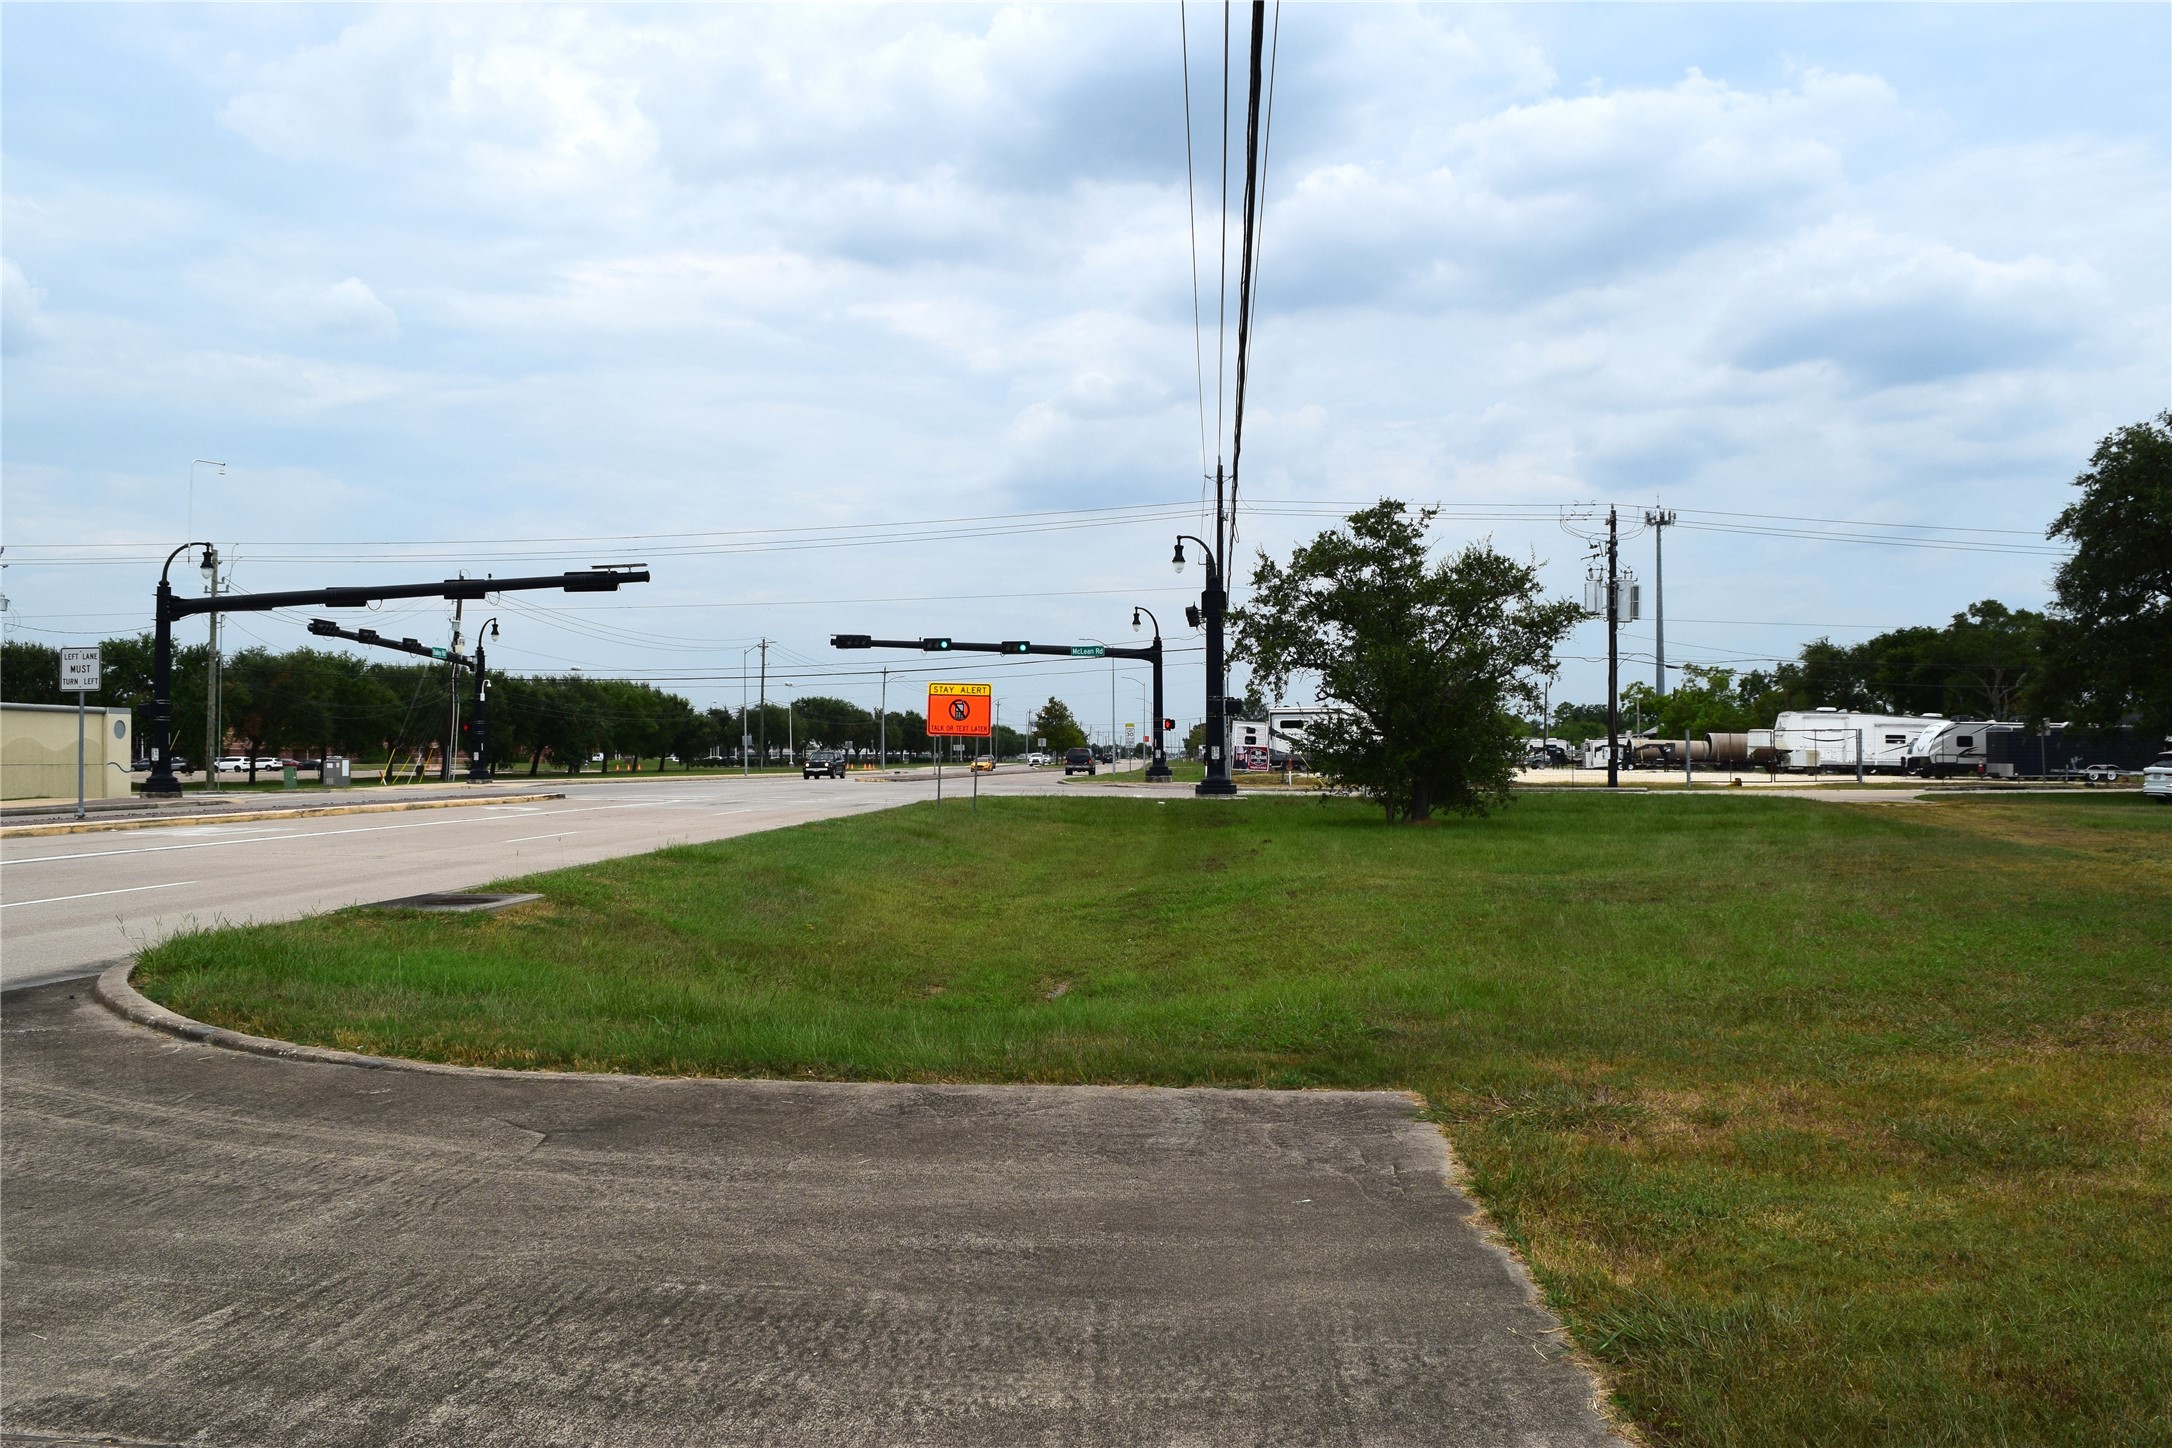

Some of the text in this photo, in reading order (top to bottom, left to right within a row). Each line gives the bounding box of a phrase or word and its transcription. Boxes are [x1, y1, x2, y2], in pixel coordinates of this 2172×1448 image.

[1072, 647, 1103, 655] McLean Rd
[70, 665, 91, 673] MUST
[83, 677, 99, 685] LEFT
[933, 686, 987, 694] STAY ALERT
